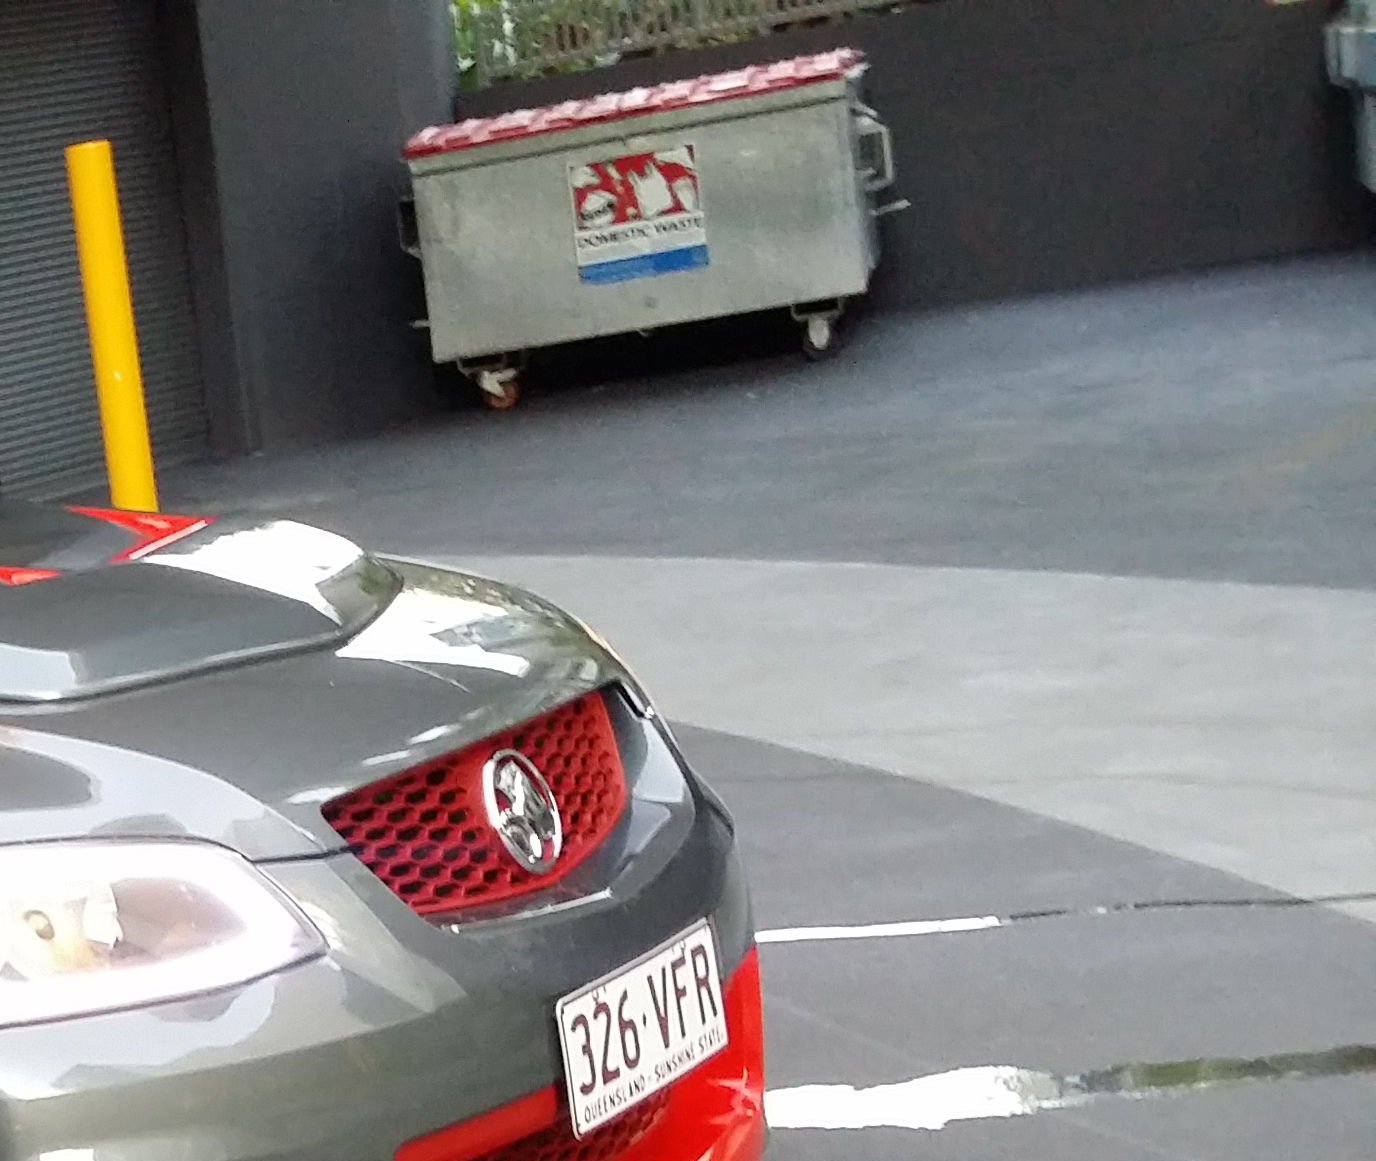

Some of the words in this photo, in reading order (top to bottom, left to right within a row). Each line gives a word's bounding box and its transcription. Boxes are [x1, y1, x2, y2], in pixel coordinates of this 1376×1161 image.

[579, 227, 649, 249] DOMESTIC
[654, 217, 704, 235] WASTE
[584, 1075, 646, 1123] QUEENSLAND
[654, 1045, 695, 1083] SUNSHINE
[698, 1030, 721, 1054] STATE
